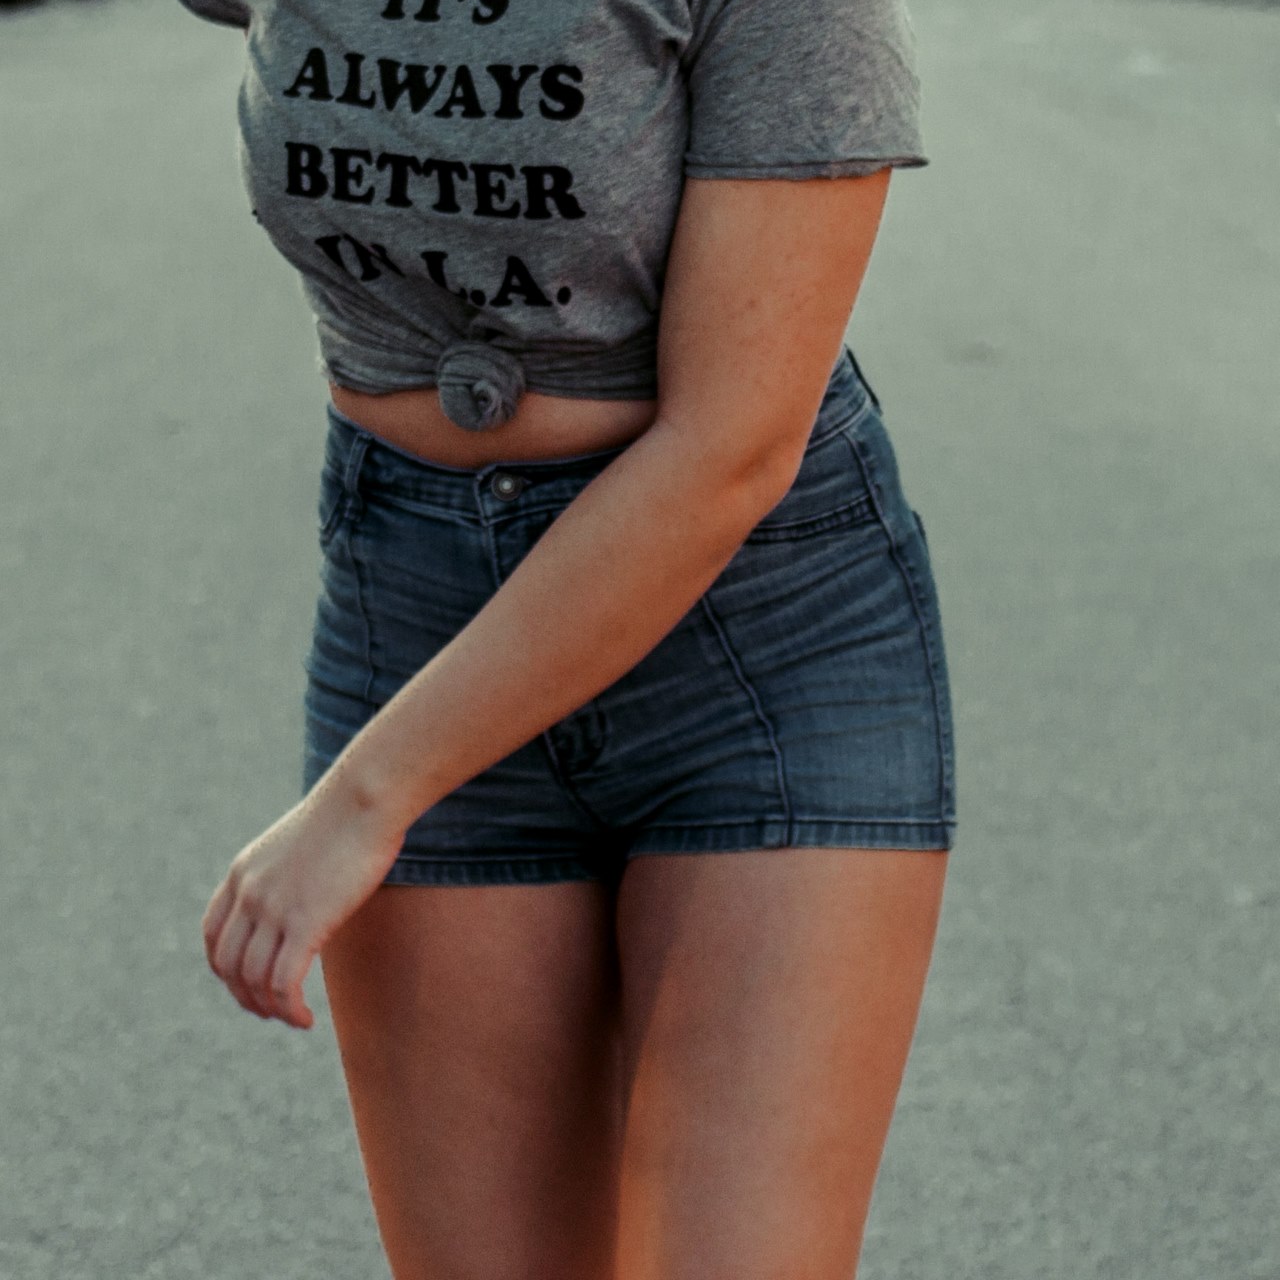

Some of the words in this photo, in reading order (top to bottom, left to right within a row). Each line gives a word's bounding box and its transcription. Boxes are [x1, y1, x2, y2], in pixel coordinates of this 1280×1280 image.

[283, 47, 585, 121] ALWAYS
[284, 141, 587, 221] BETTER
[420, 250, 572, 307] L.A.
